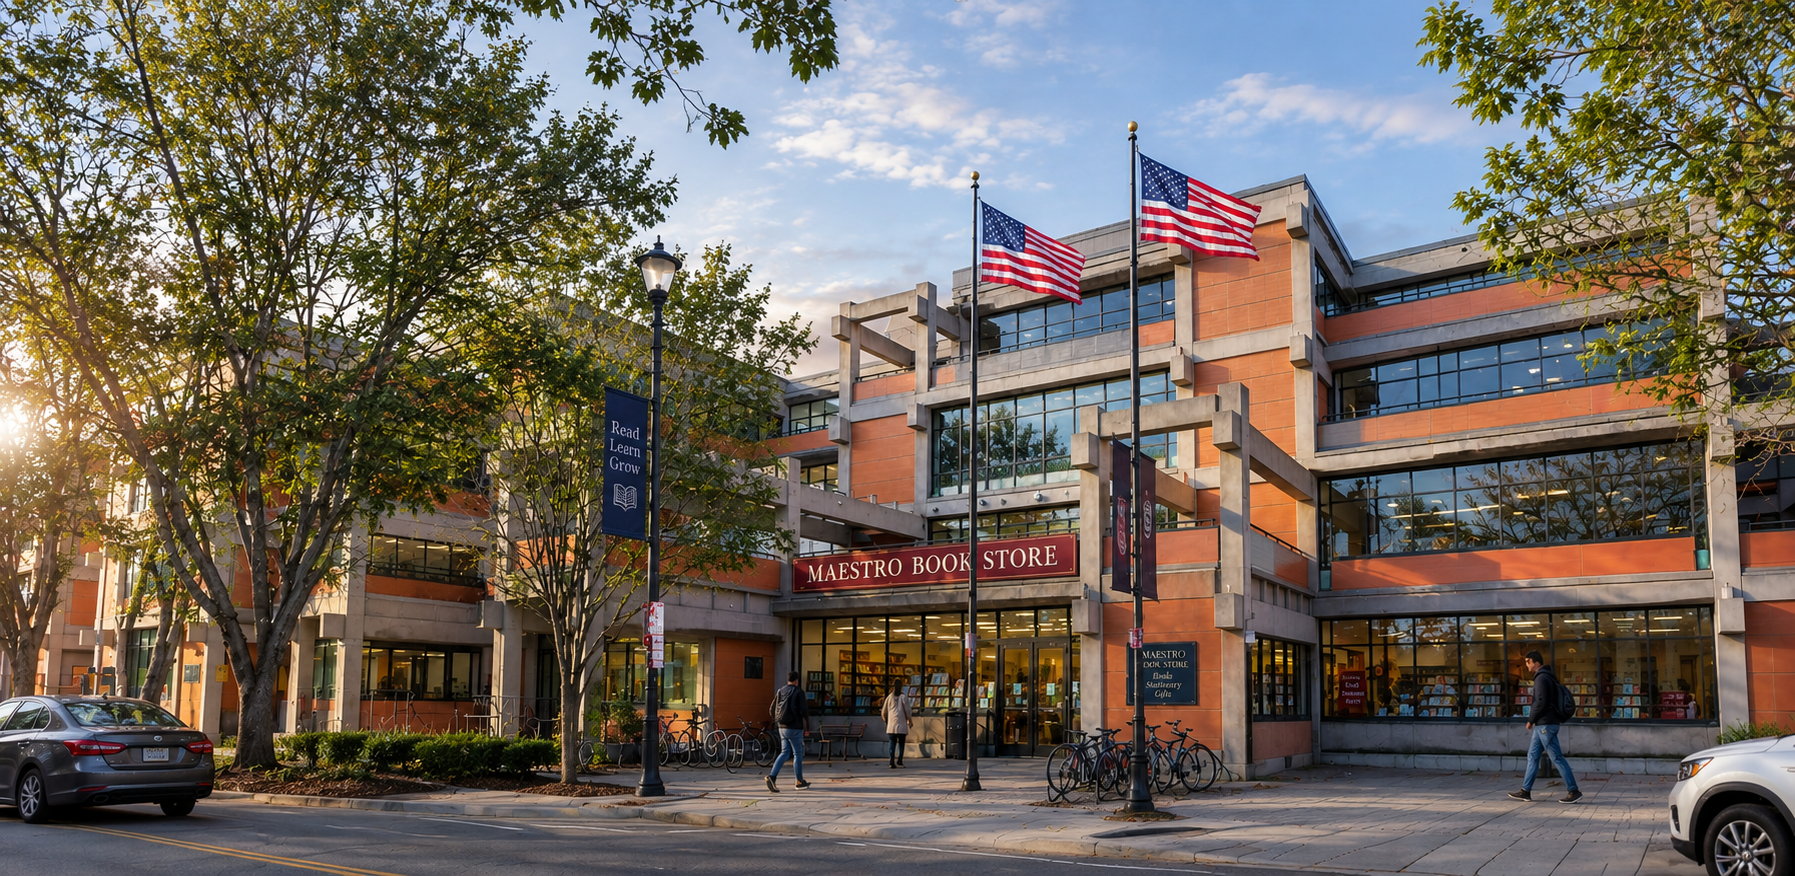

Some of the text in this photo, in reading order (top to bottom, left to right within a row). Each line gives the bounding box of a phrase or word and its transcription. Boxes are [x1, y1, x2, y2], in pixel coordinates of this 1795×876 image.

[611, 420, 640, 440] Read
[610, 456, 641, 474] Grow
[807, 545, 1058, 583] MAESTRO BOOK STORE
[1142, 650, 1186, 659] MAESTRO
